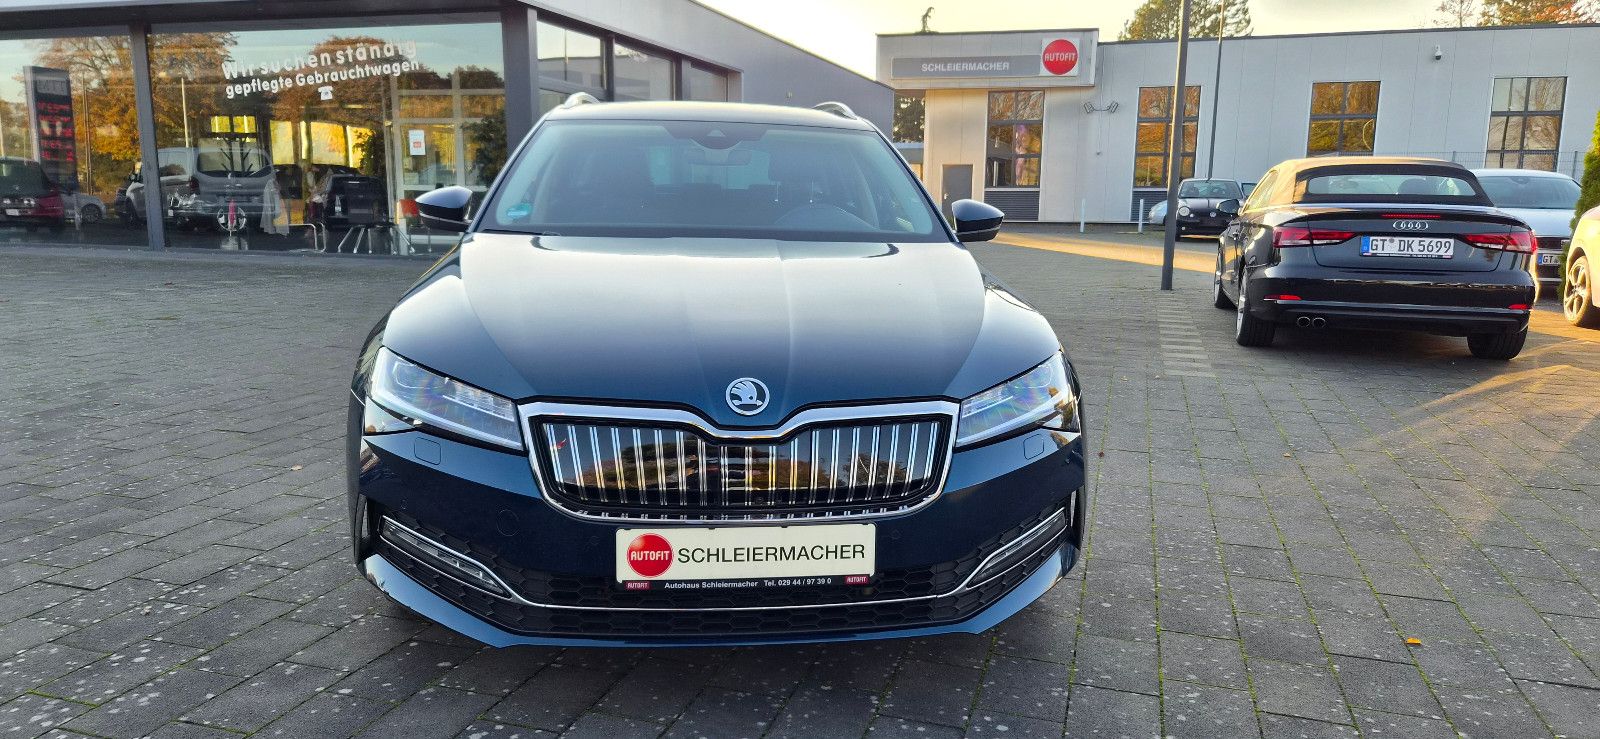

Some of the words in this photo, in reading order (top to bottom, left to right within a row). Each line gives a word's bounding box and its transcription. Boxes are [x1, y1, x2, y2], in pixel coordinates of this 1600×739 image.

[221, 60, 254, 79] Wir
[260, 51, 334, 75] suchen
[336, 40, 417, 64] ständig
[1044, 52, 1077, 62] AUTOFIT
[921, 62, 1009, 72] SCHLEIERMACHER
[225, 76, 294, 99] gepflegte
[295, 58, 420, 86] Gebrauchtwagen
[1370, 238, 1387, 252] GT
[1398, 239, 1415, 253] DK
[1417, 240, 1452, 254] 5699
[1543, 255, 1553, 264] GT
[631, 551, 669, 560] AUTOFIT
[678, 545, 865, 563] SCHLEIERMACHER
[664, 581, 700, 589] Autohaus
[701, 580, 758, 589] Schleiermacher
[764, 579, 777, 587] Tel.
